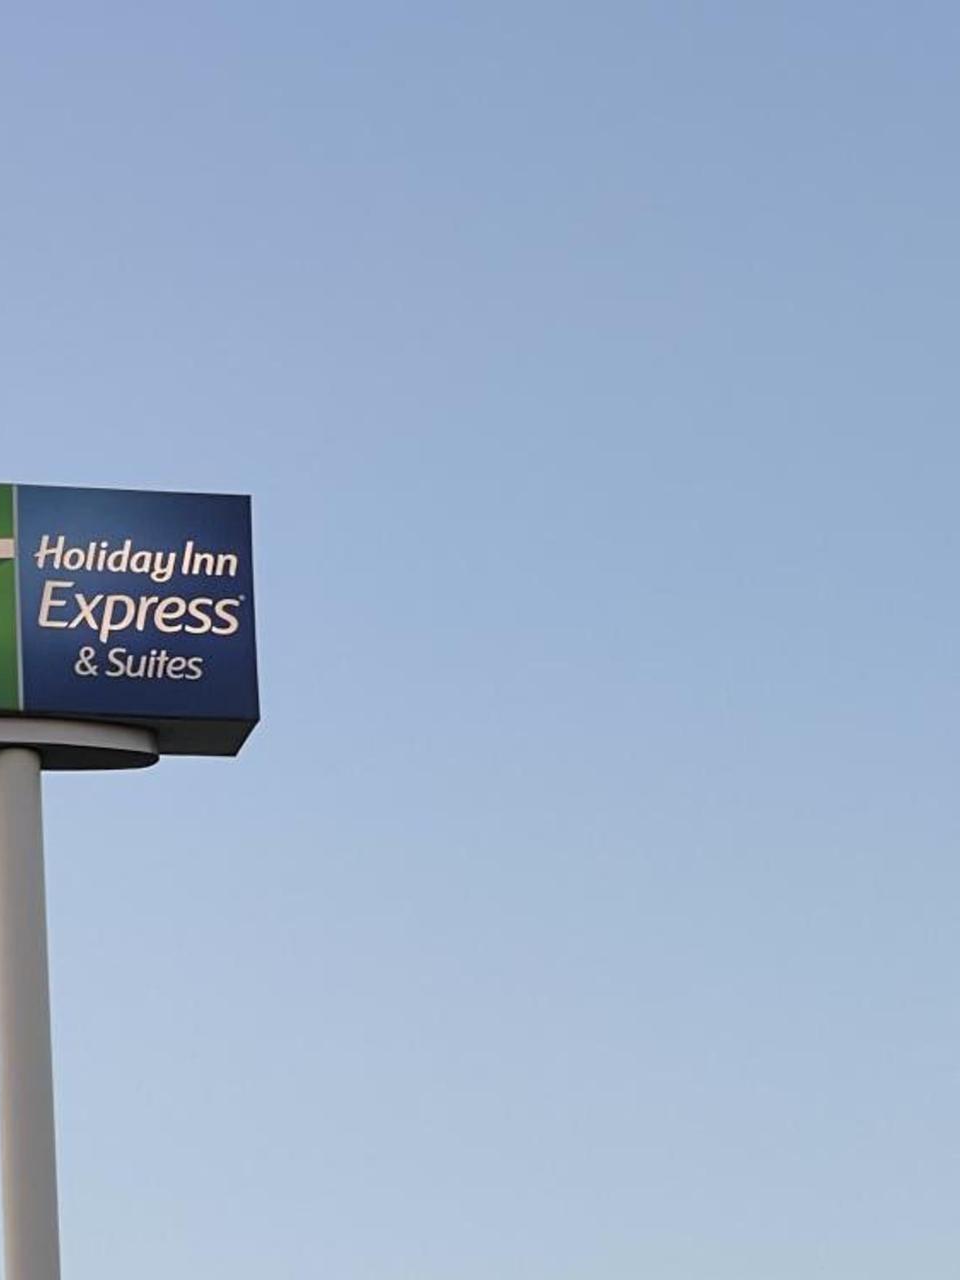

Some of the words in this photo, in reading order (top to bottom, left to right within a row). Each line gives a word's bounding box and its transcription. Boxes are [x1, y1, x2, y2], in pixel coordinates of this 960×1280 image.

[34, 534, 176, 583] Holiday
[181, 540, 238, 577] Inn
[38, 579, 240, 644] Express
[74, 646, 98, 677] &
[105, 647, 203, 680] Suites
